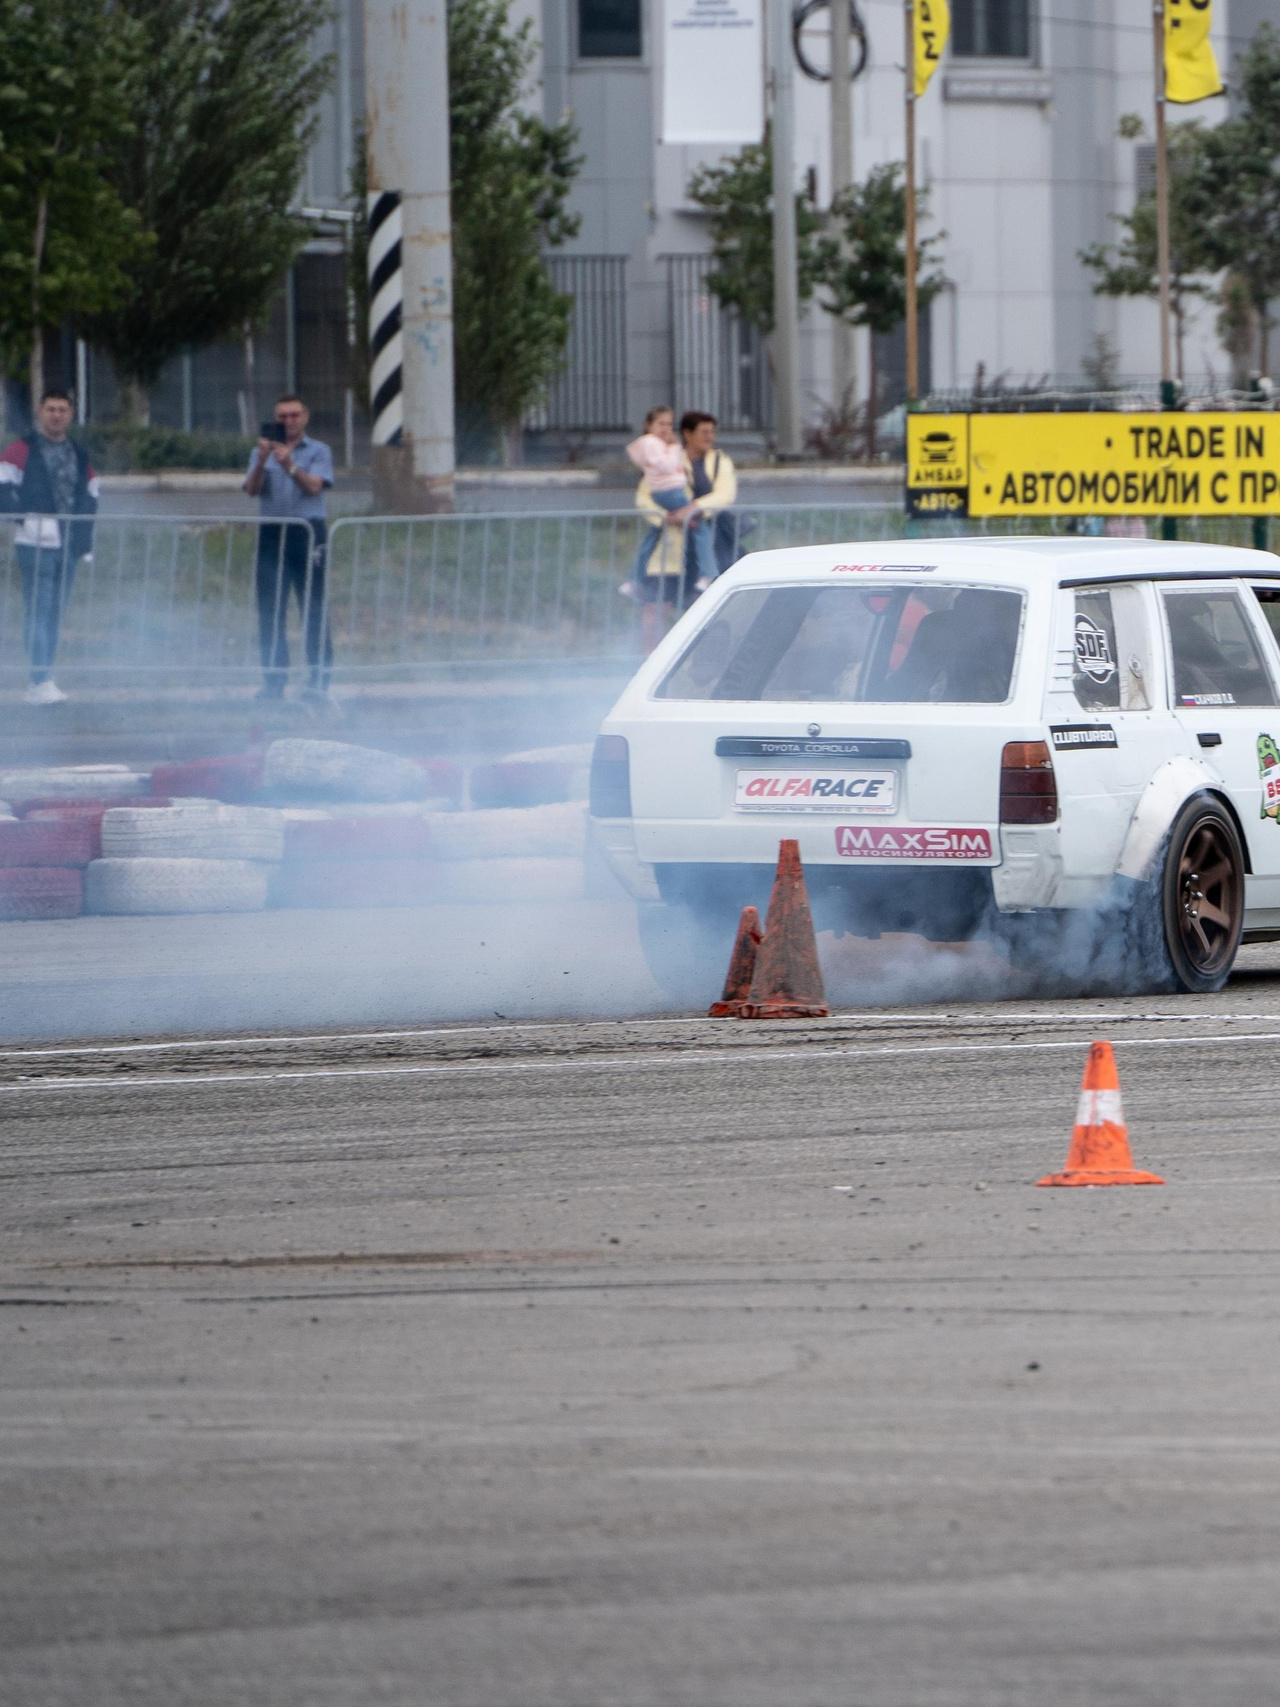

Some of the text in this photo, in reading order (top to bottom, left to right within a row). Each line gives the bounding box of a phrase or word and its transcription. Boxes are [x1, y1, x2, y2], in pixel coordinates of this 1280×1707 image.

[1129, 425, 1265, 459] TRADE IN
[914, 467, 963, 482] АМБАР
[999, 471, 1200, 504] АВТОМОБИЛИ
[1210, 471, 1229, 504] С
[918, 492, 961, 511] АВТО
[1074, 631, 1107, 660] SDF
[1051, 730, 1116, 744] CLUBTURBO
[760, 743, 860, 754] TOYOTA COROLLA
[840, 849, 990, 859] АВТОСИМУЛЯТОРЫ
